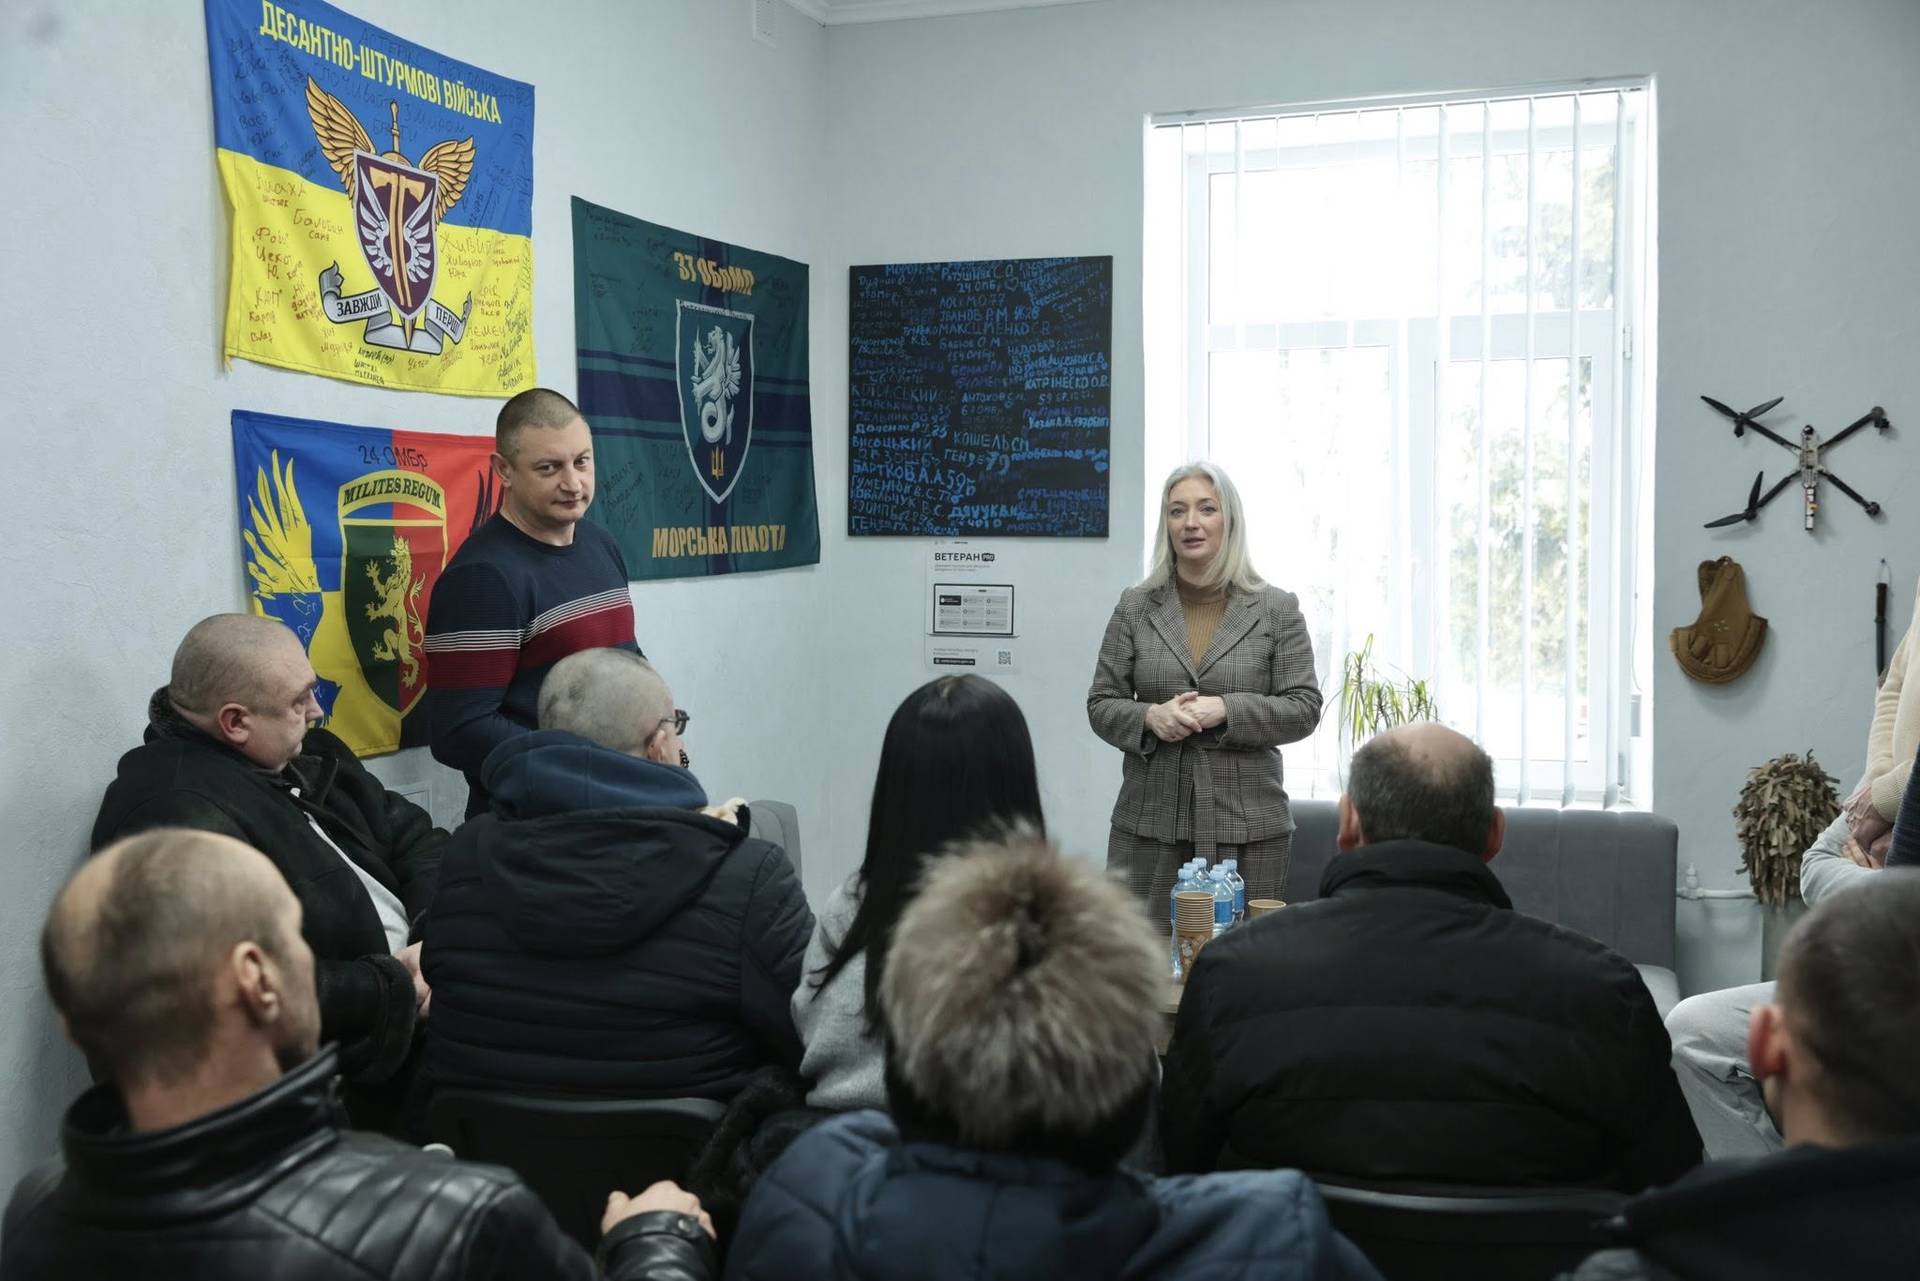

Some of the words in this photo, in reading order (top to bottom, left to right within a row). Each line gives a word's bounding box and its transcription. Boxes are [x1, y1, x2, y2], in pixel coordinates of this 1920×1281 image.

[259, 0, 441, 105] ДЕСАНТНО-ШТУРМОВІ
[443, 79, 502, 125] ВІЙСЬКА
[336, 290, 383, 318] ЗАВЖДИ
[358, 445, 380, 465] 24
[343, 477, 401, 507] MILITES
[402, 478, 441, 509] REGUM
[652, 525, 728, 559] МОРСЬКА
[934, 552, 980, 561] ВЕТЕРАН
